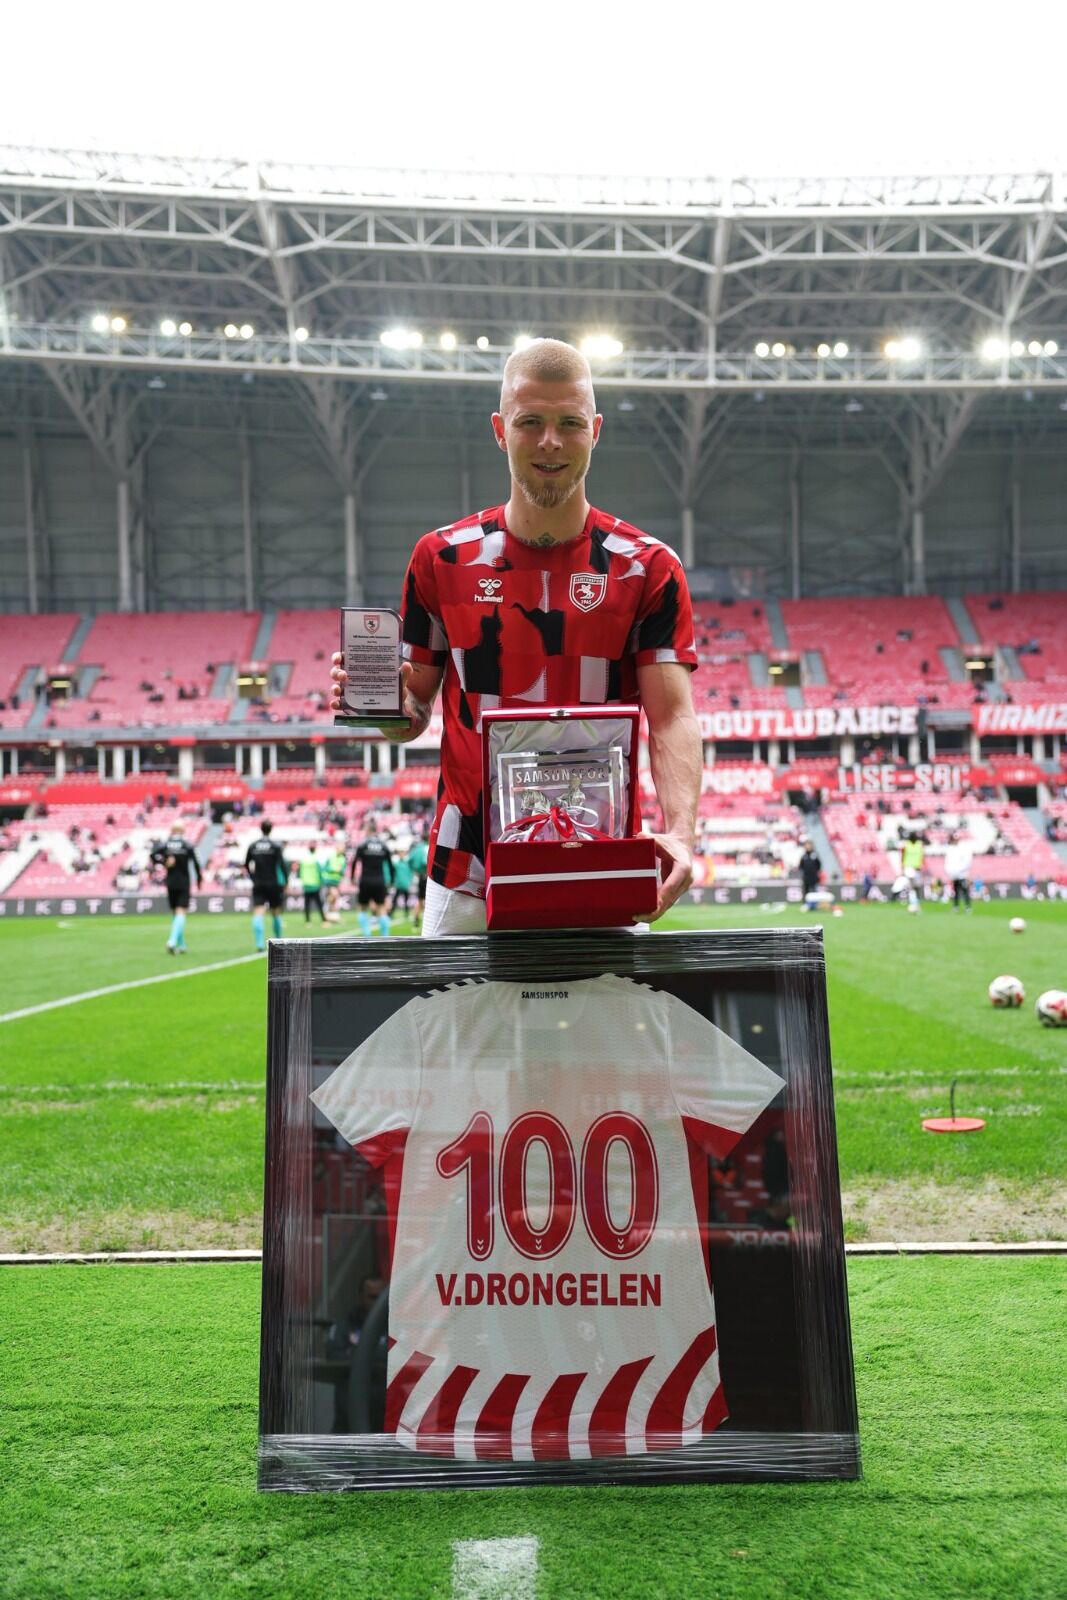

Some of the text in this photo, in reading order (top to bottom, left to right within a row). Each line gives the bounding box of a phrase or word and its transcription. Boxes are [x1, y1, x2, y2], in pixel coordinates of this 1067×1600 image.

[474, 594, 503, 603] hummel
[516, 768, 605, 784] SAMSUNSPOR
[521, 991, 569, 1000] SAMSUNSPOR
[435, 1110, 660, 1262] 100
[435, 1272, 662, 1307] V.DRONGELEN
